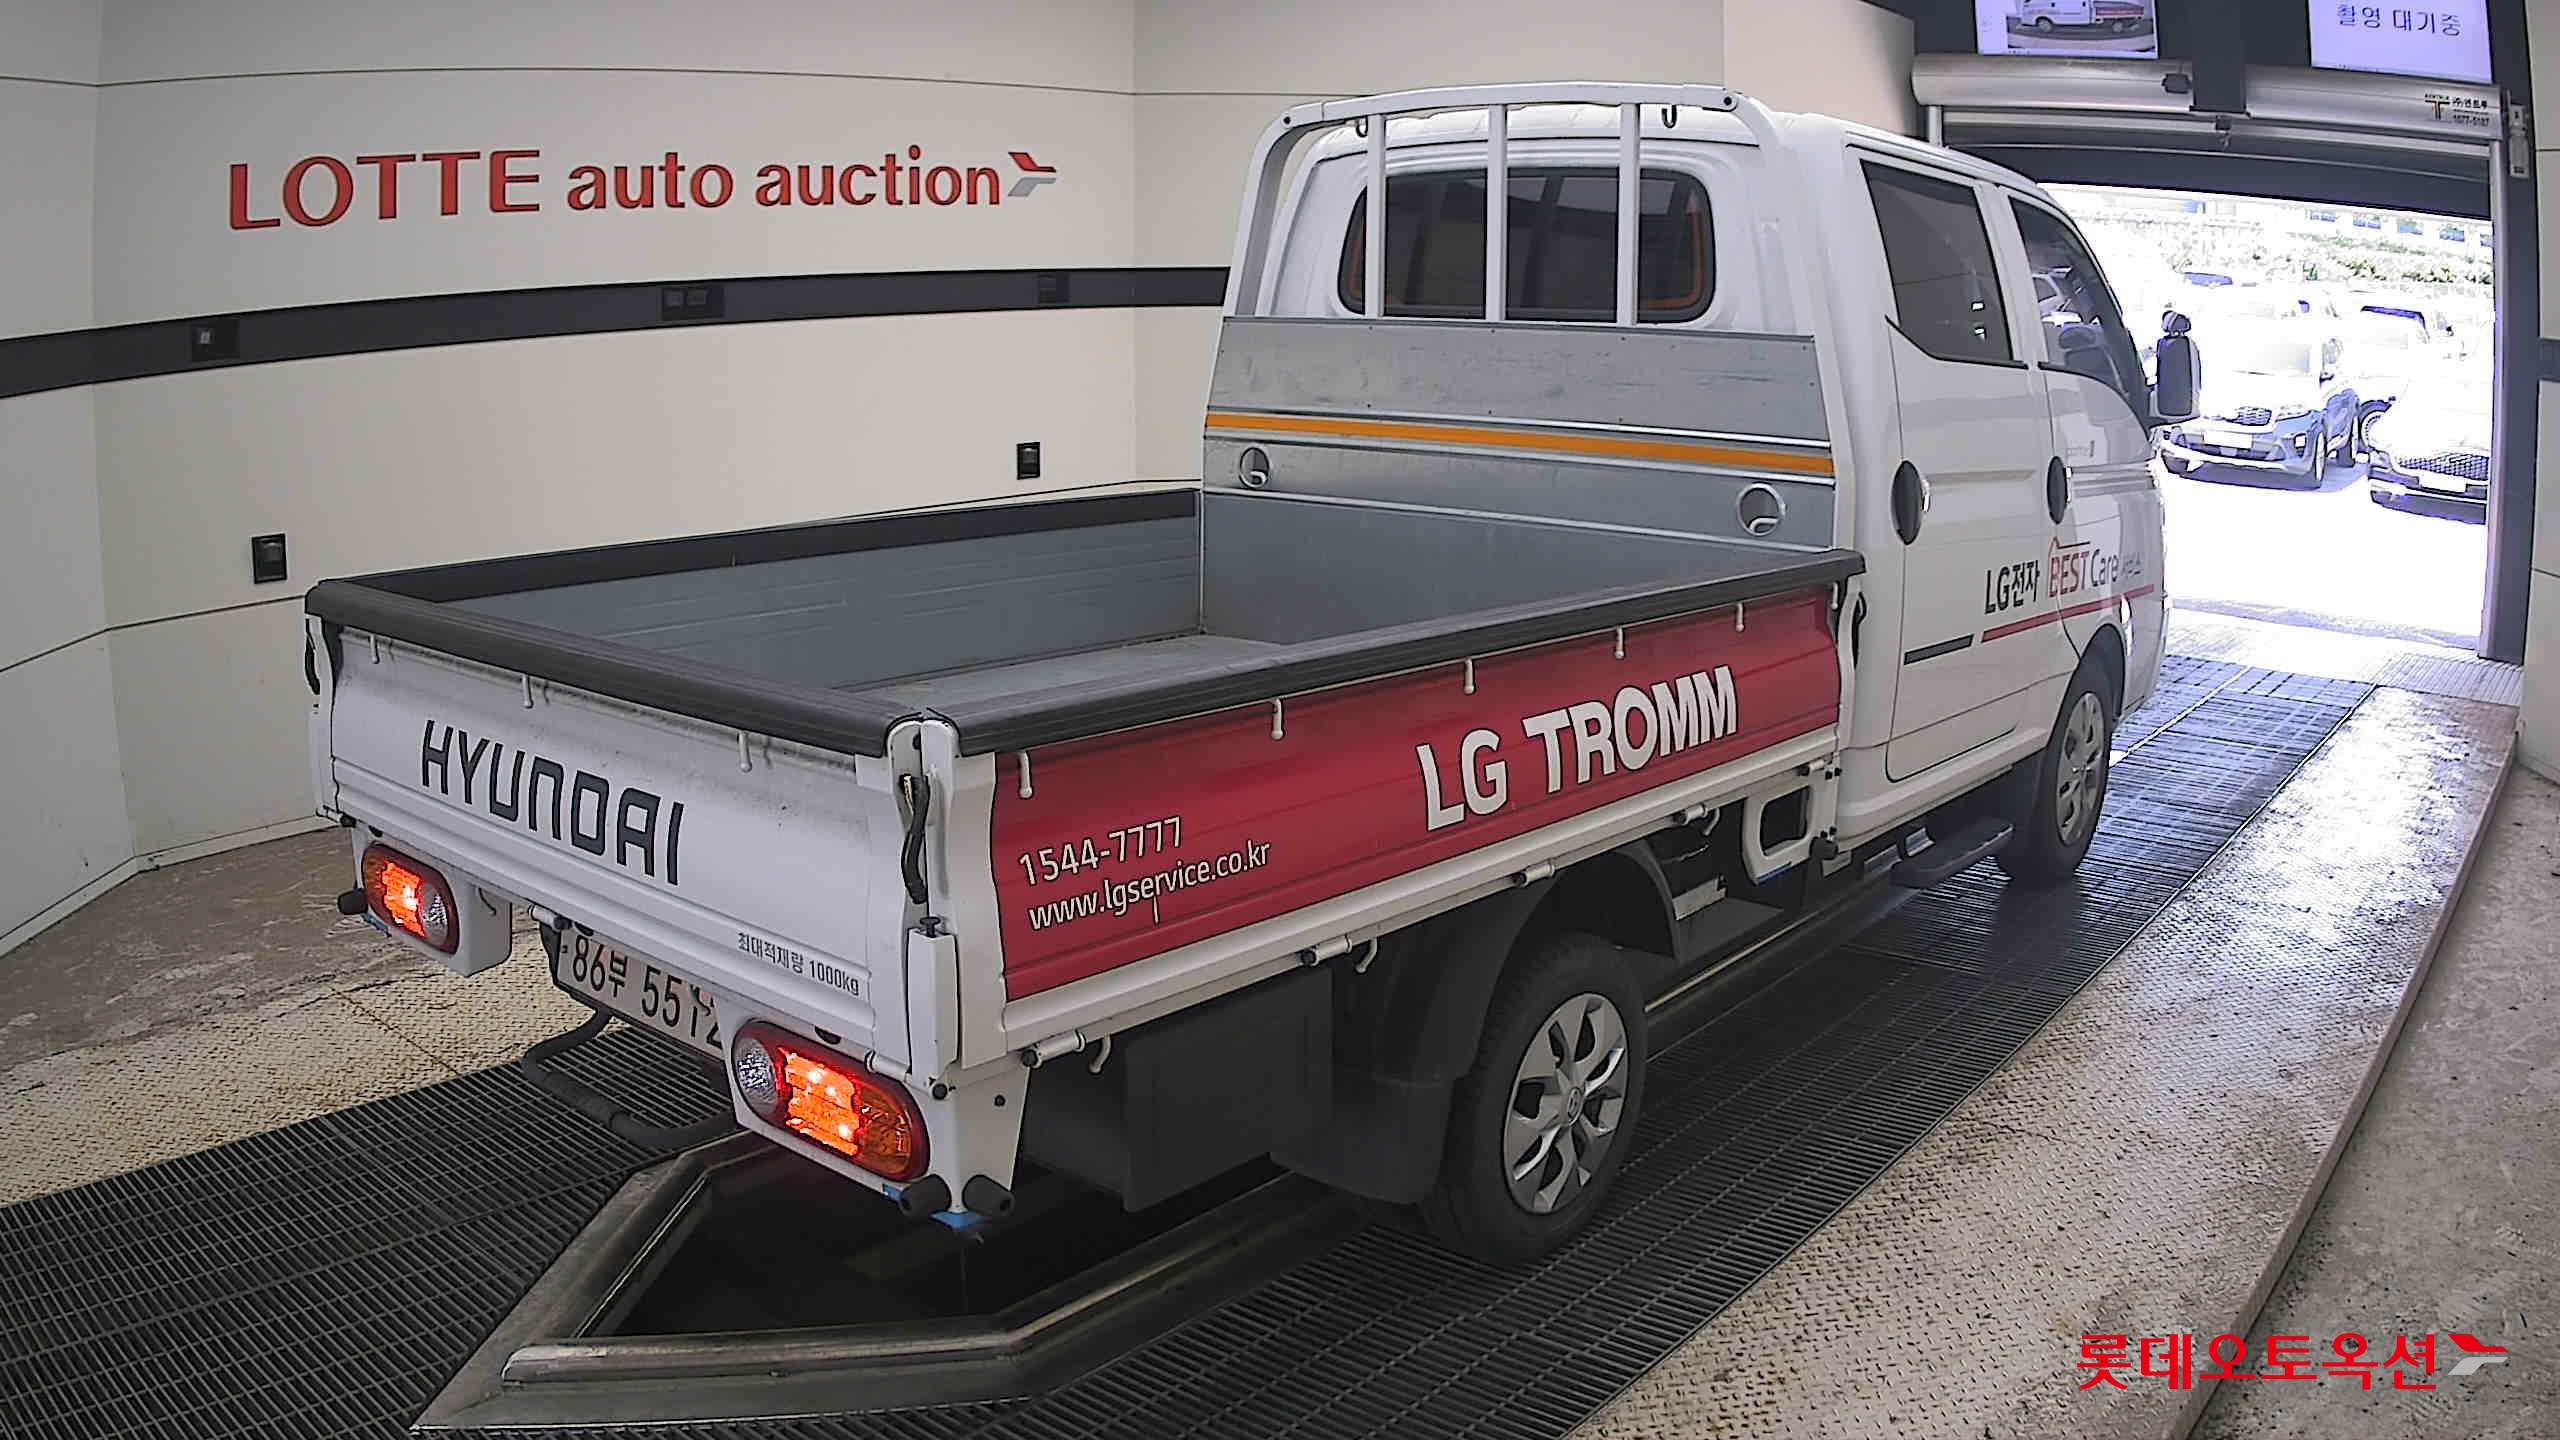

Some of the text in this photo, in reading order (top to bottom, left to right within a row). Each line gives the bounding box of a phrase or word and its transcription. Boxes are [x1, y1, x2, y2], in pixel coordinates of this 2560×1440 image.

[2392, 9, 2462, 37] 대기중
[229, 145, 1001, 230] LOTTE auto auction
[1984, 560, 2040, 614] LG전자
[2048, 551, 2090, 597] BEST
[2091, 549, 2119, 587] Care
[1416, 665, 1739, 832] LG TROMM
[421, 719, 685, 887] HYUNDAI
[1018, 816, 1181, 886] 1544-7777
[1028, 839, 1272, 930] www.lgservice.co.kr
[572, 934, 629, 998] 86부
[738, 932, 860, 997] 최대적재량 1000kg
